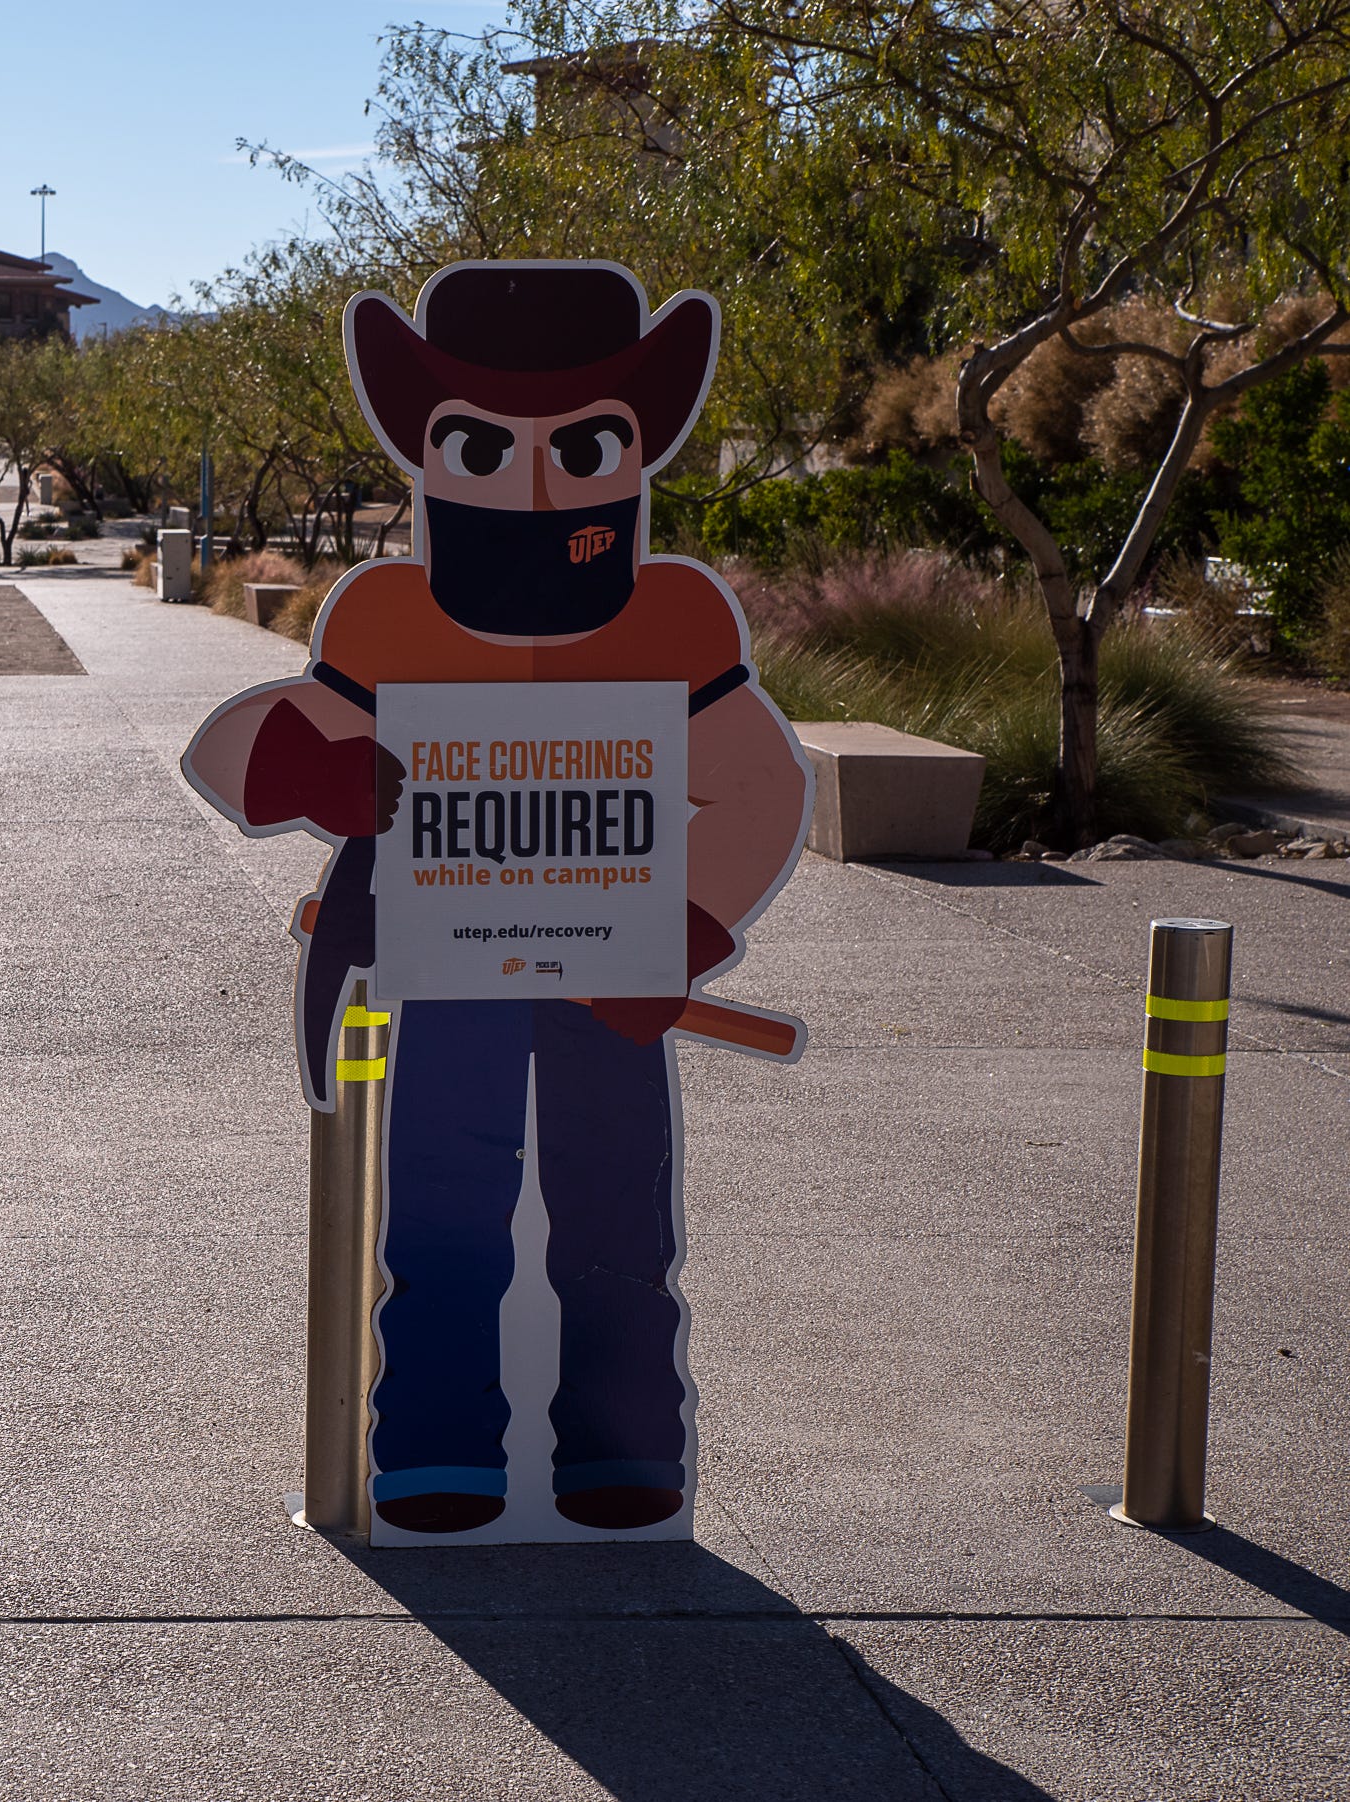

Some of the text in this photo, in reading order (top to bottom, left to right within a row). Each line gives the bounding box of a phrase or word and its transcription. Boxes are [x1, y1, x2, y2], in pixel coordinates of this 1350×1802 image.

[568, 525, 616, 564] UTEP
[412, 739, 653, 781] FACE COVERINGS
[412, 790, 654, 865] REQUIRED
[413, 864, 652, 889] while on campus
[453, 924, 613, 942] utep.edu/recovery
[502, 957, 526, 975] UTEP
